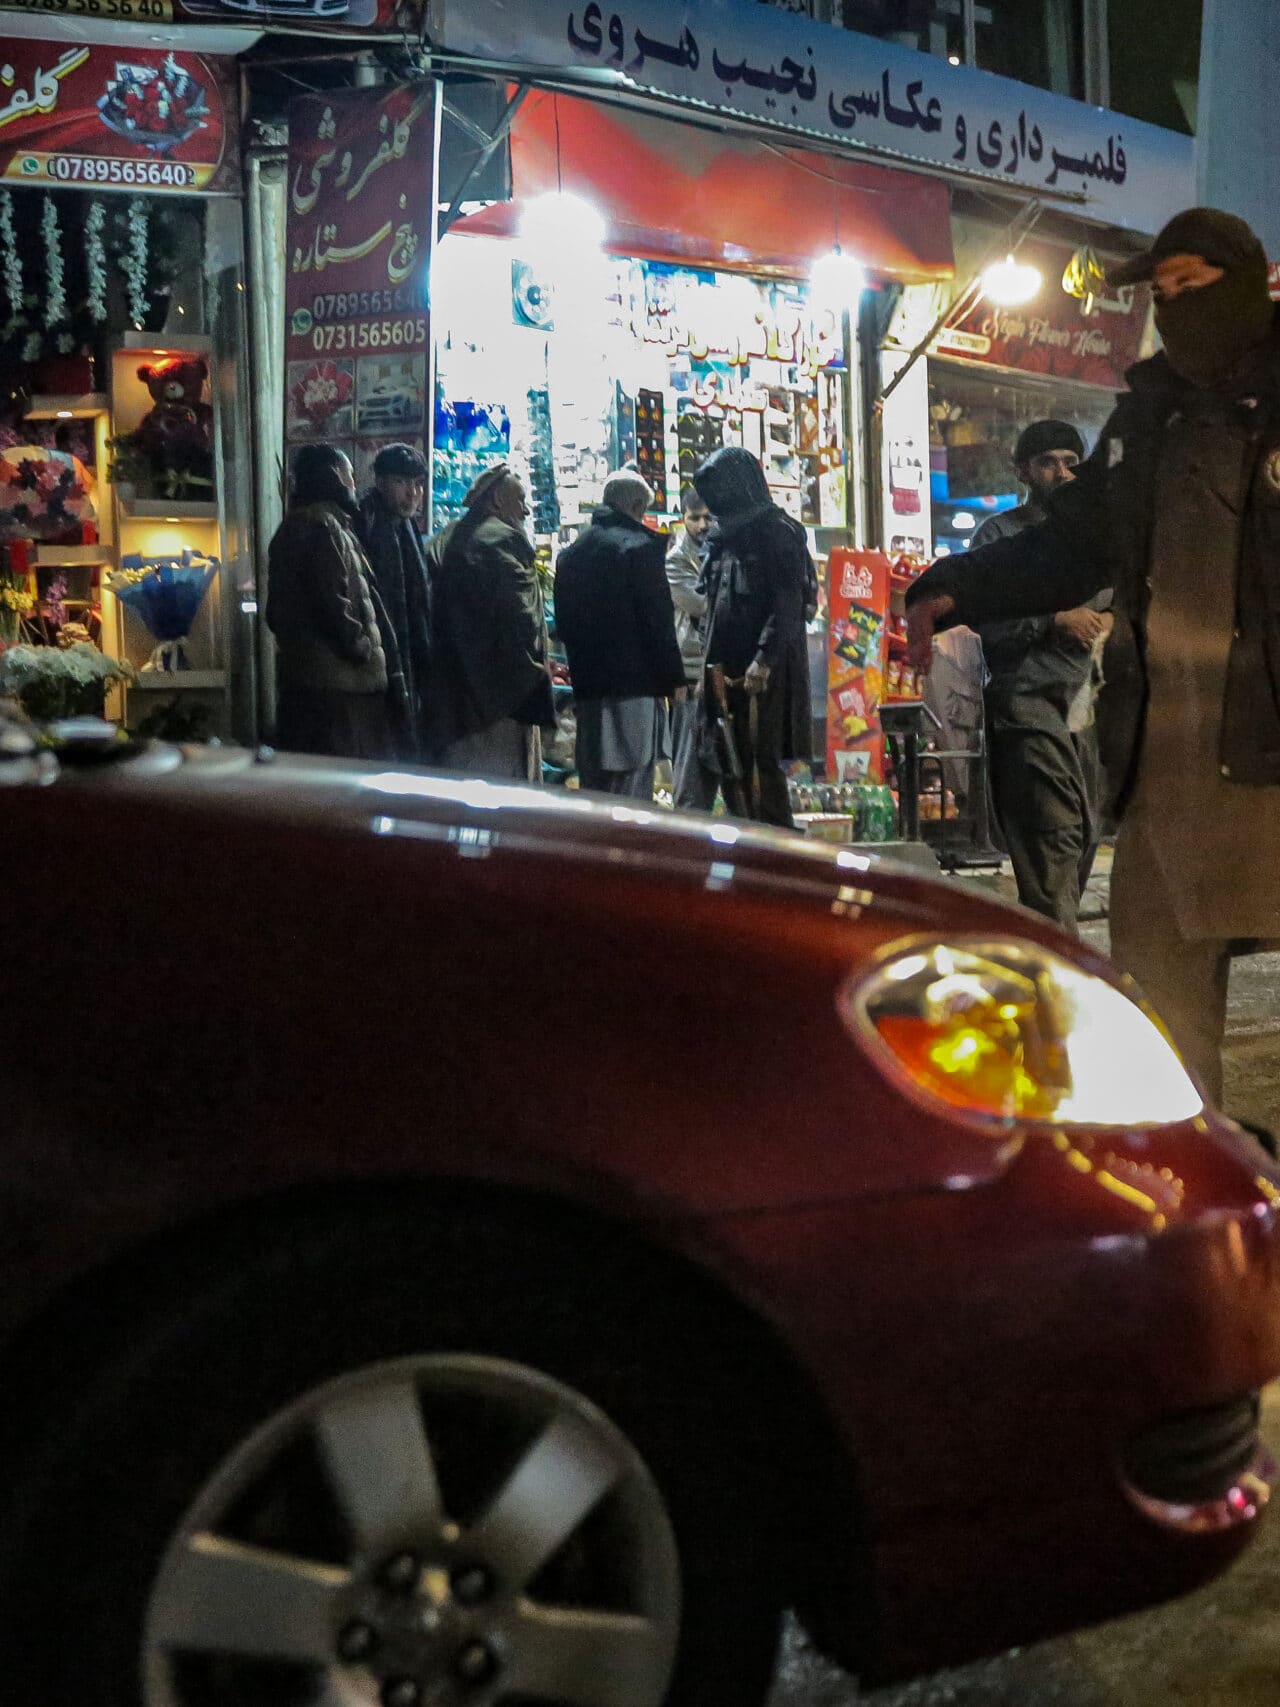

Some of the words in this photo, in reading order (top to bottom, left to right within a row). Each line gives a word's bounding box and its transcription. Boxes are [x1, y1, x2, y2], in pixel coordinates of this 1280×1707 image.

[567, 2, 699, 73] هروی
[712, 47, 817, 116] نجیب
[829, 69, 942, 132] عکاسی
[953, 114, 967, 161] و
[56, 158, 187, 186] 0789565640
[293, 220, 392, 273] ستاره
[388, 193, 418, 283] پنج
[312, 319, 426, 350] 0731565605
